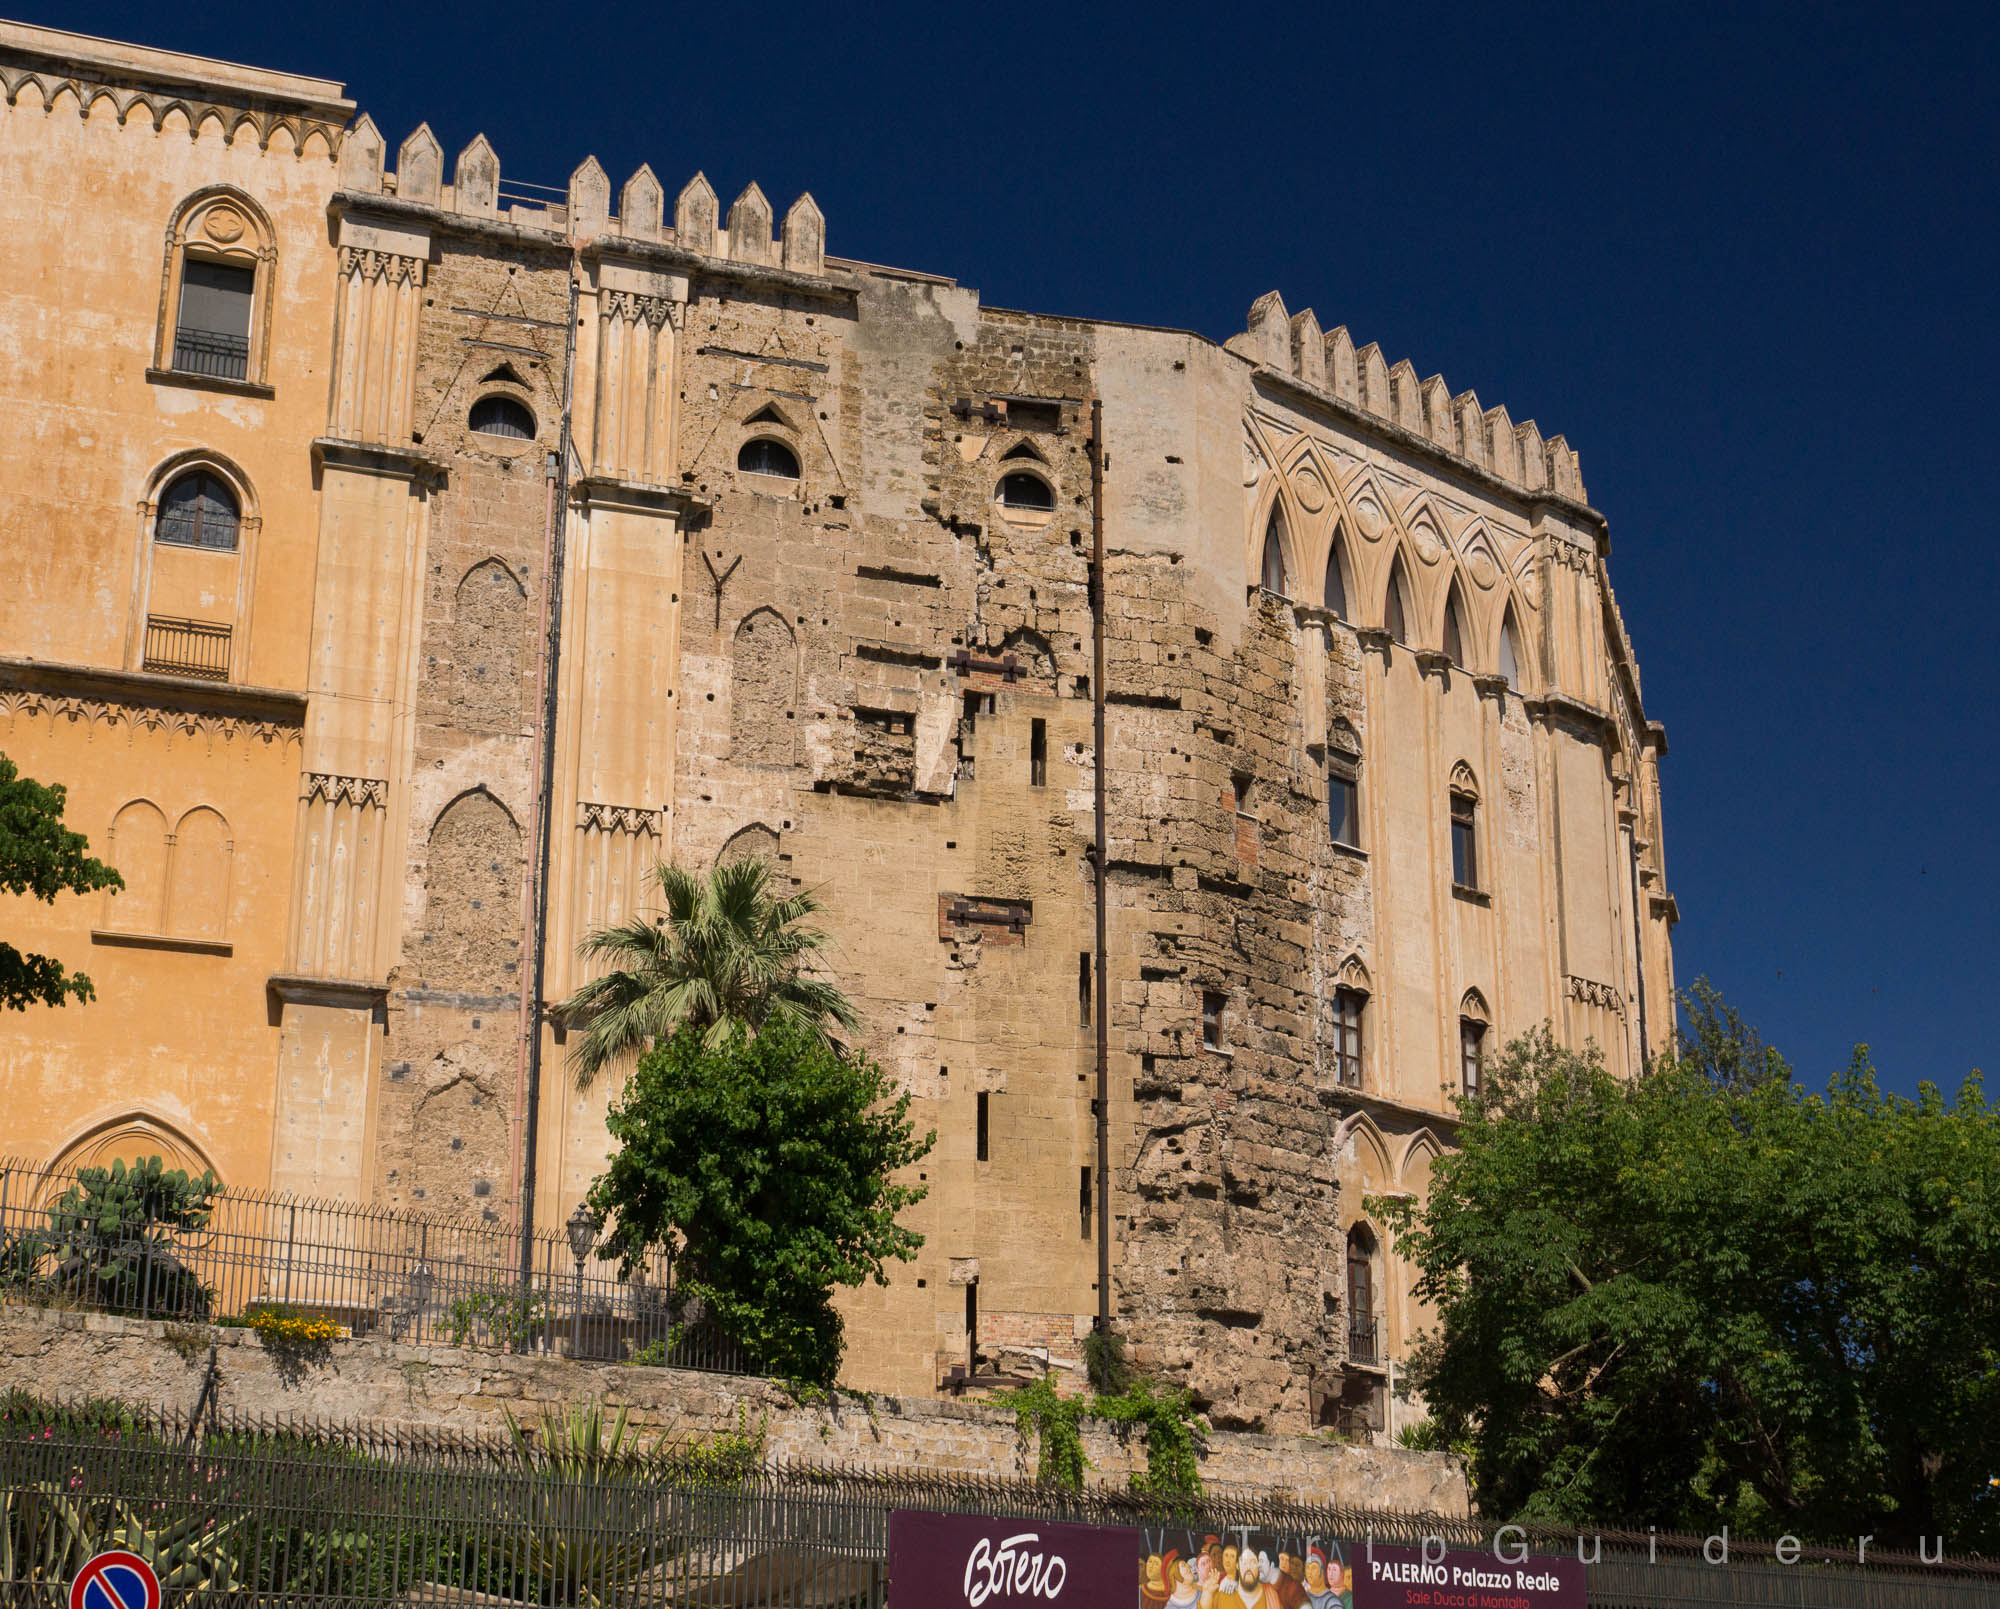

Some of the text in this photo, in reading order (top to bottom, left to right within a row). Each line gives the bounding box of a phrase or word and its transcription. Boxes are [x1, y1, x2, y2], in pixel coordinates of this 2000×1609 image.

[1372, 1561, 1560, 1591] PALERMO Palazzo Reale
[1406, 1589, 1531, 1609] Sale Duca di Montalto
